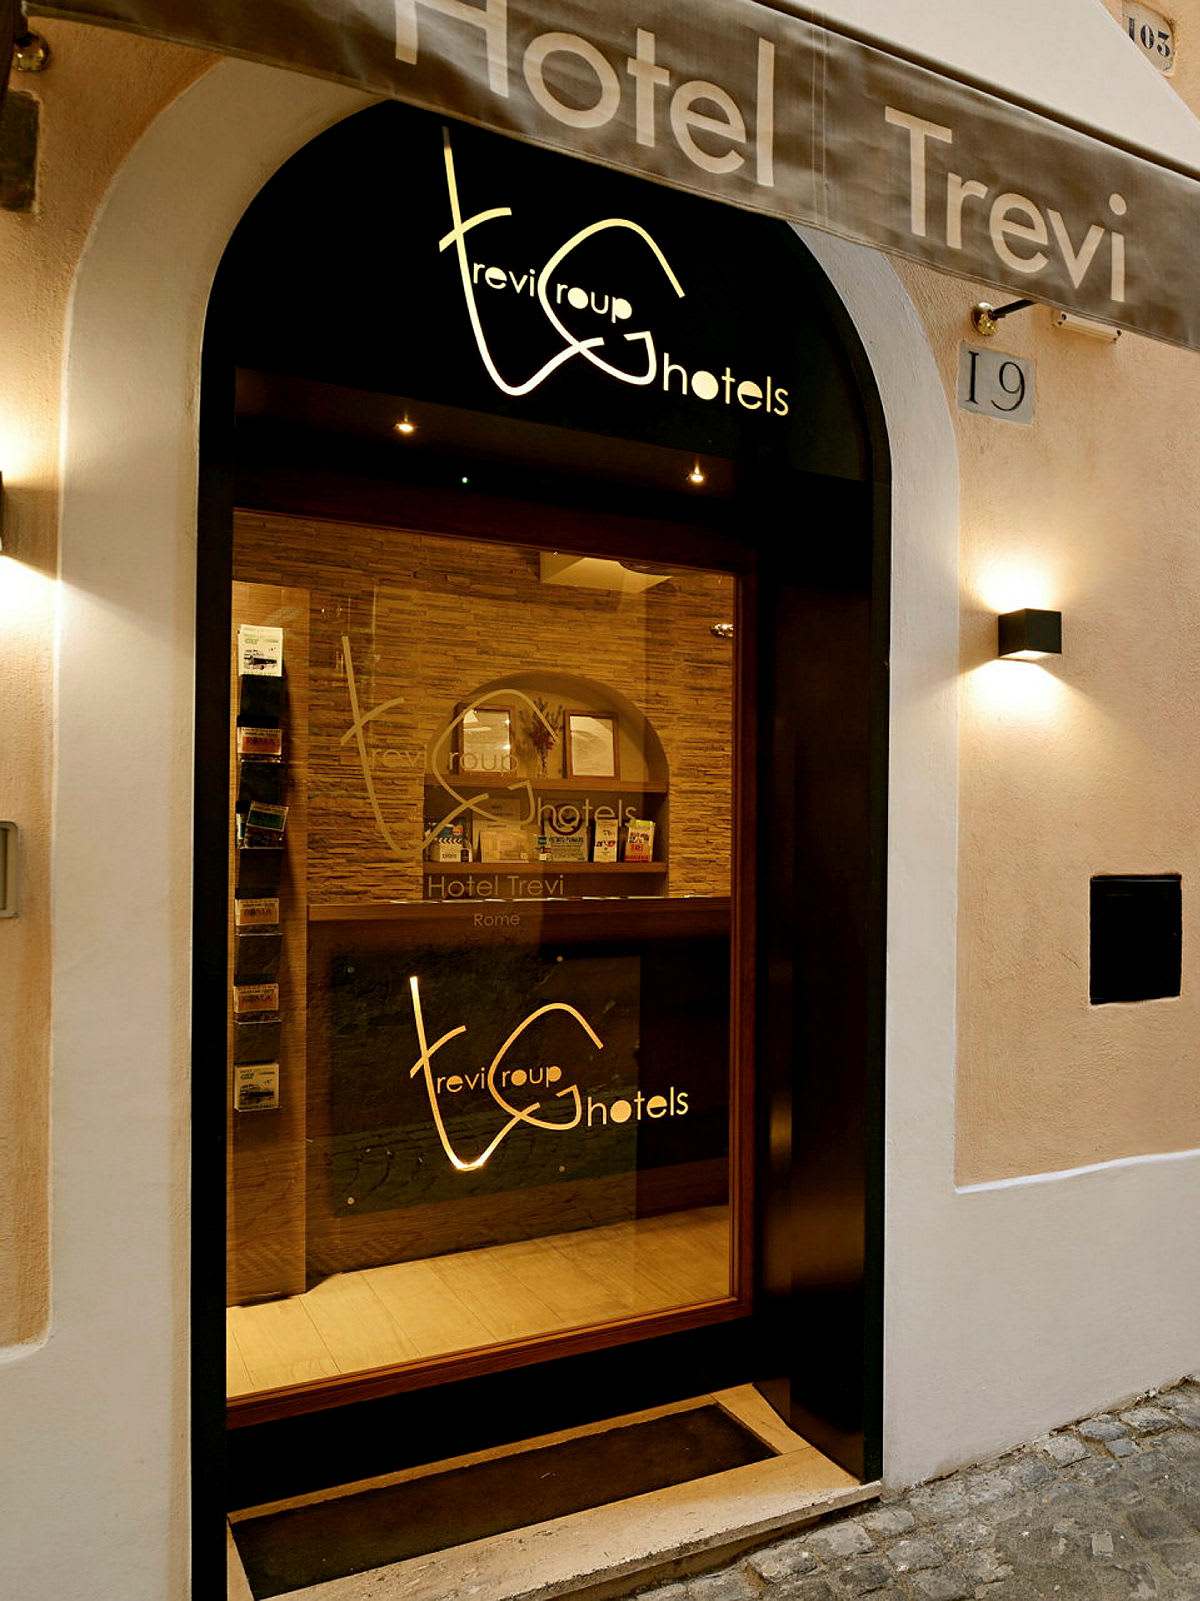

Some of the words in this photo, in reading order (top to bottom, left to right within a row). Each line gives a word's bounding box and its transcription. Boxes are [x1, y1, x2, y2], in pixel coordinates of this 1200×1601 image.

[1127, 17, 1171, 58] 103
[394, 0, 776, 188] Hotel
[884, 105, 1128, 303] Trevi
[662, 352, 790, 418] hotels
[962, 350, 1026, 412] 19
[537, 796, 638, 829] hotels
[427, 873, 500, 899] Hotel
[507, 873, 565, 897] Trevi
[473, 911, 520, 928] Rome
[587, 1087, 690, 1127] hotels
